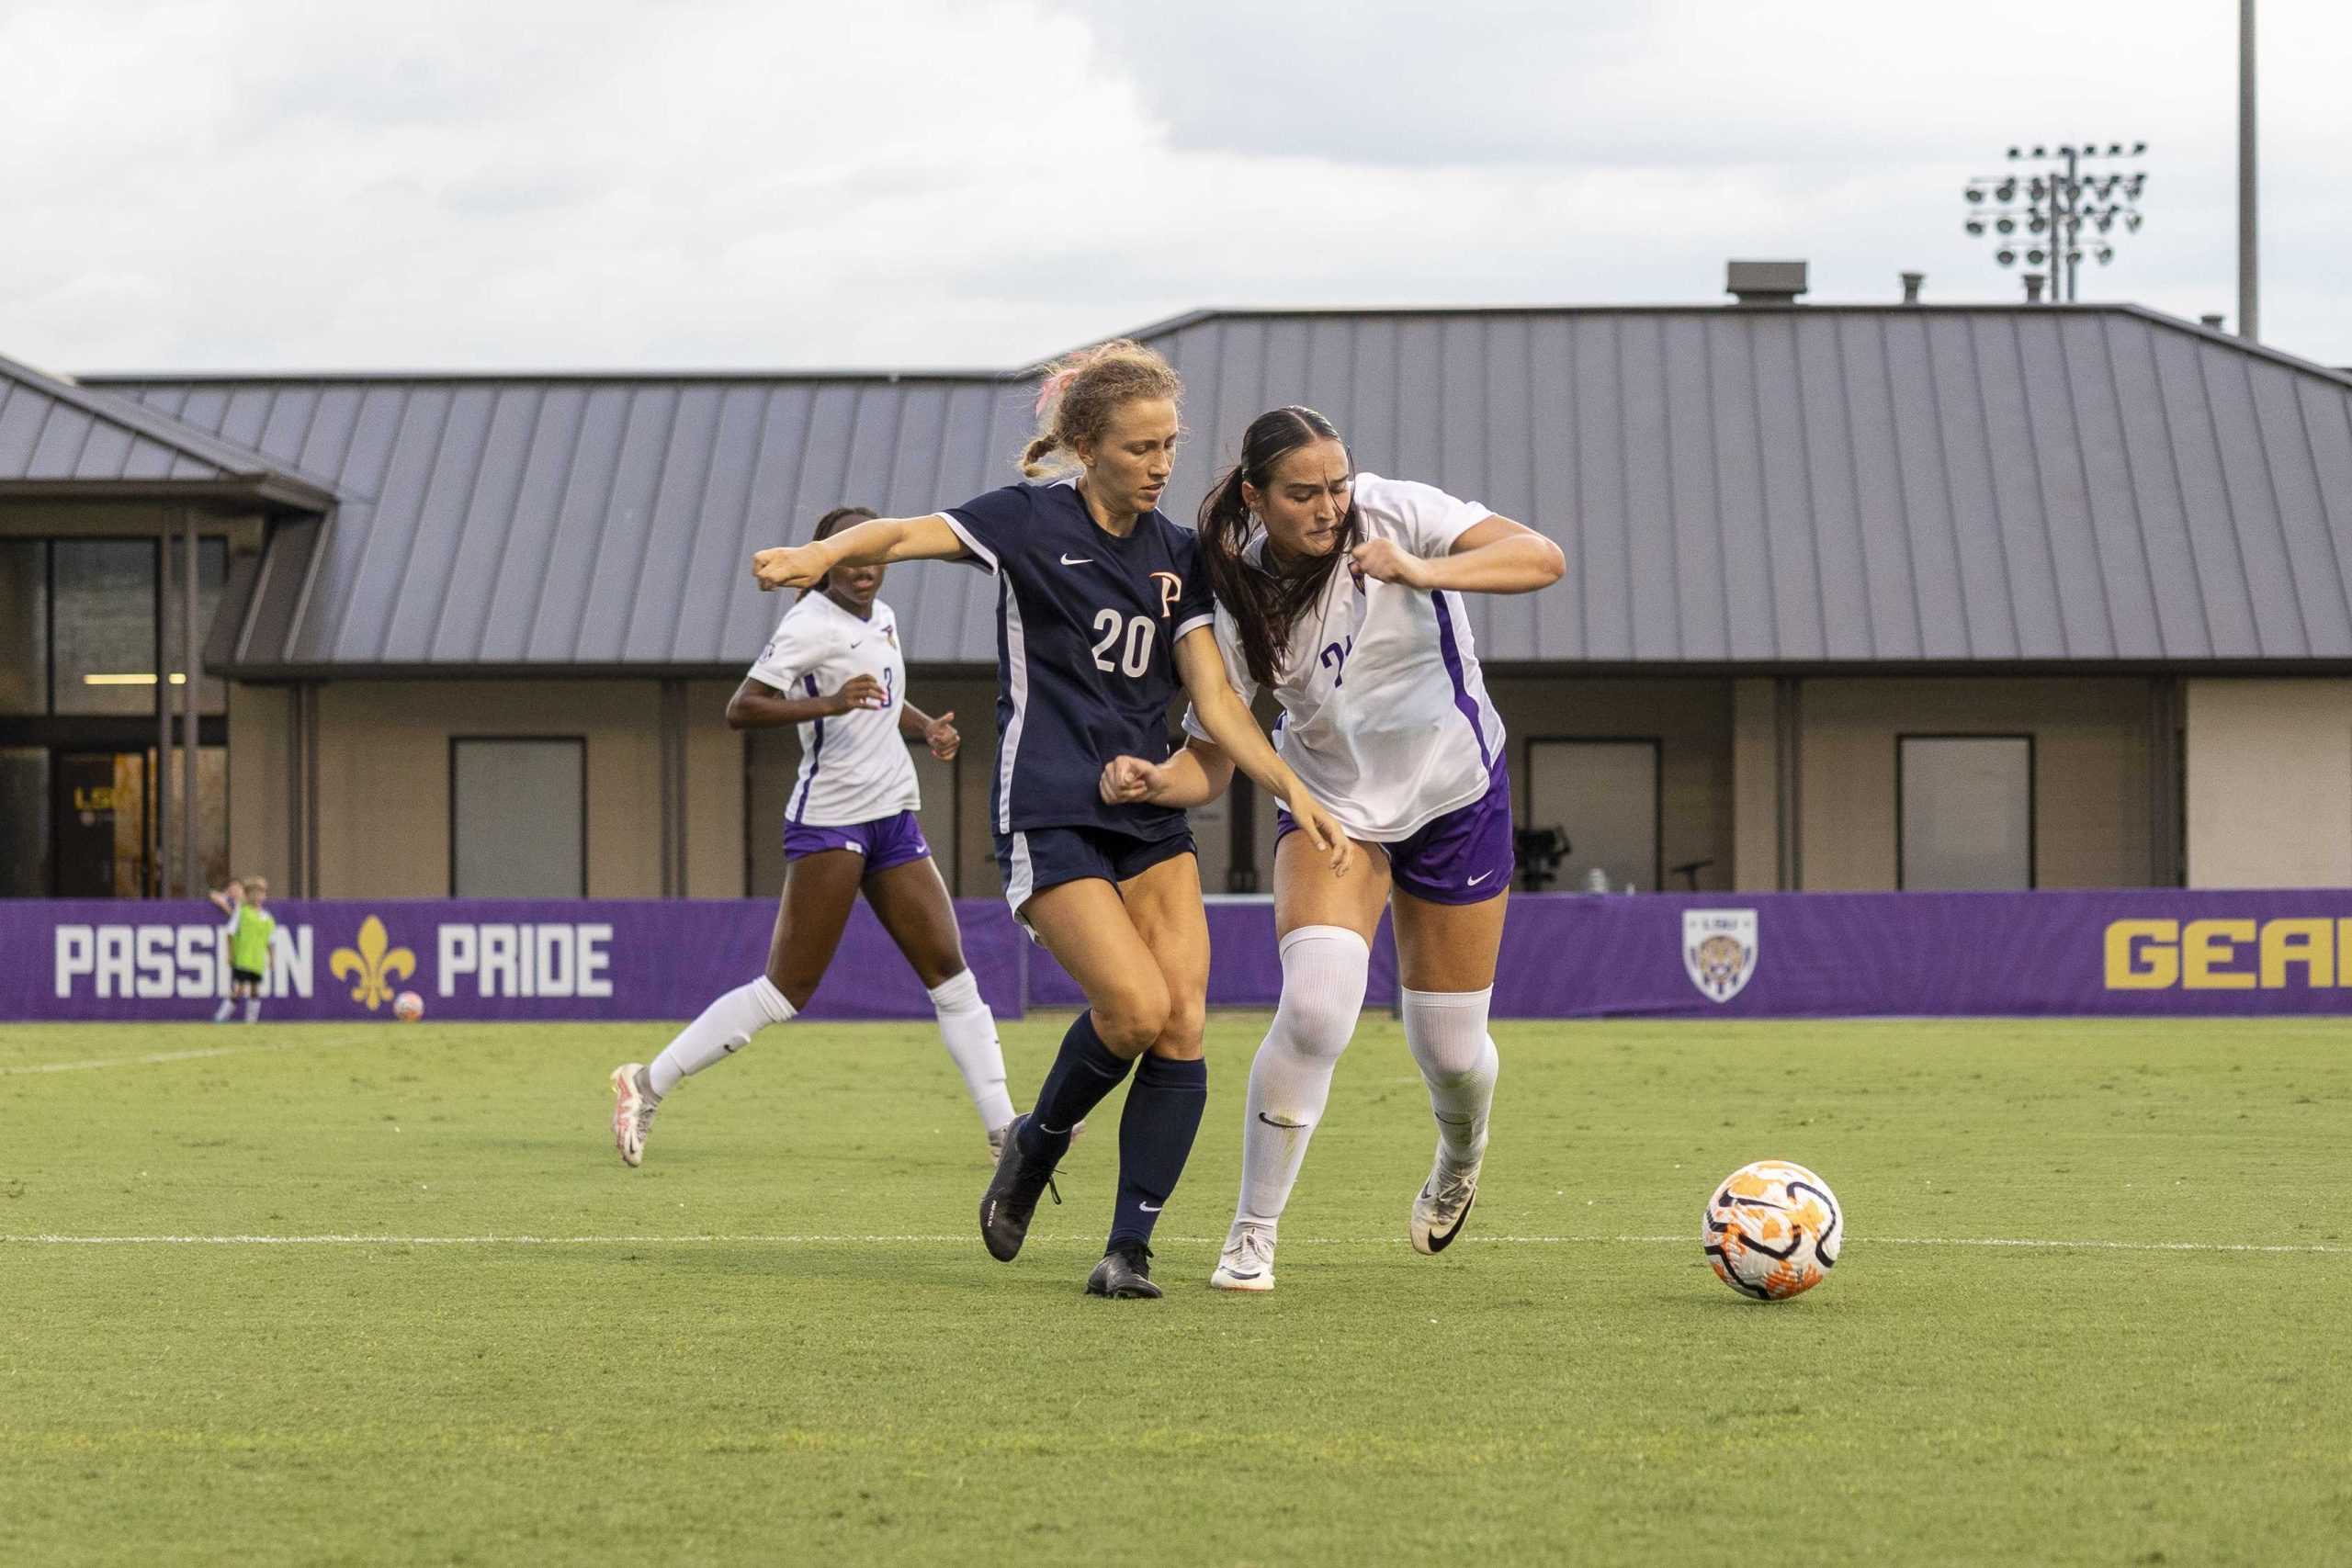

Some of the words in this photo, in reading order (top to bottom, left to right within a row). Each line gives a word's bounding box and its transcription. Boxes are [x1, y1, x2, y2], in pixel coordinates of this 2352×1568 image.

[1091, 608, 1156, 678] 20
[1319, 635, 1353, 689] 2
[55, 924, 313, 998] PASSIN
[438, 923, 613, 998] PRIDE
[2104, 919, 2352, 989] GEA
